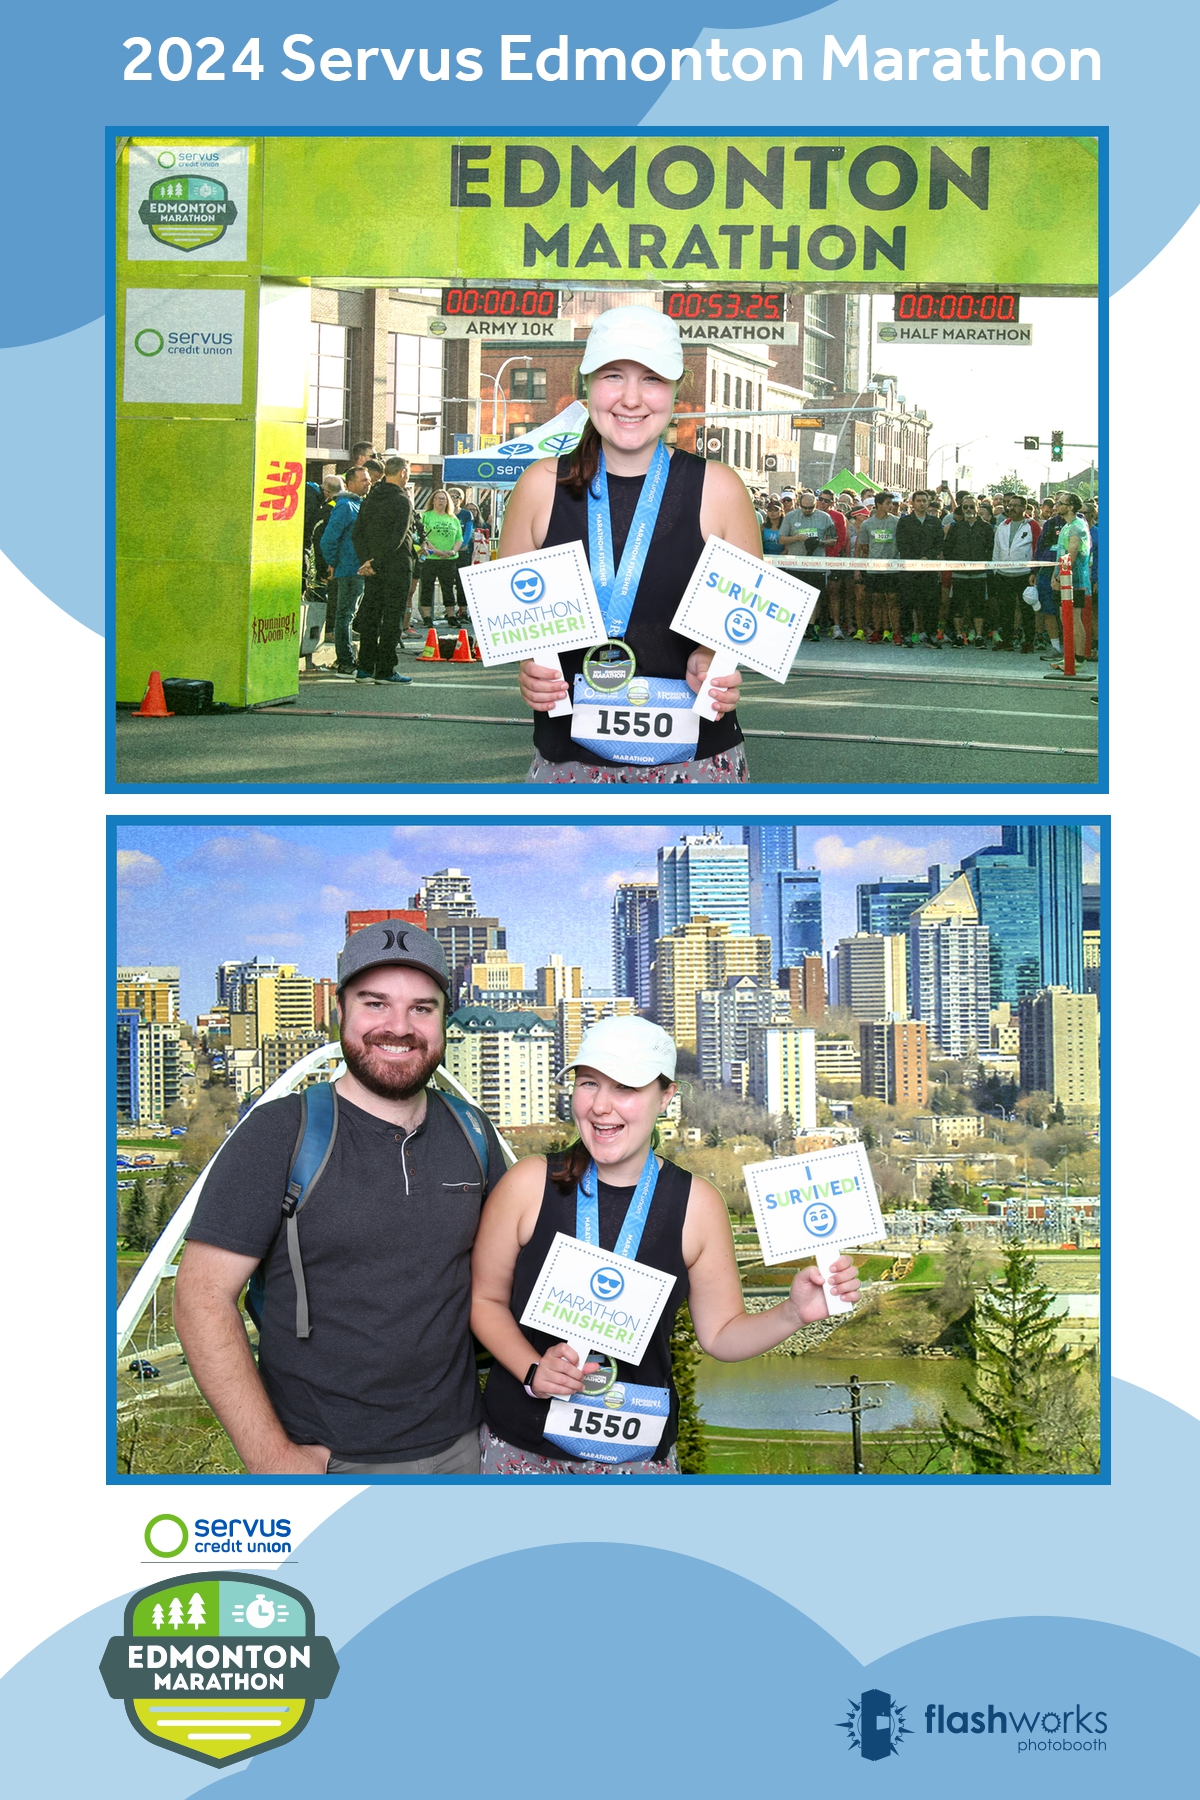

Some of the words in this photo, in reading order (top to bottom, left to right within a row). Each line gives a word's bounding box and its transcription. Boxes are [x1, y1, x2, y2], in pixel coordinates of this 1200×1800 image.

[178, 152, 219, 161] servus
[450, 144, 991, 211] EDMONTON
[149, 203, 227, 213] EDMONTON
[160, 214, 215, 222] MARATHON
[523, 224, 907, 271] MARATHON
[168, 331, 233, 345] servus
[465, 321, 518, 335] ARMY
[521, 322, 554, 336] 10K
[679, 325, 785, 340] MARATHON
[900, 328, 938, 340] HALF
[943, 328, 1031, 341] MARATHON
[168, 345, 200, 355] credit
[202, 345, 233, 355] union
[496, 465, 529, 475] serv
[596, 513, 604, 551] MARATHON
[630, 522, 646, 561] MARATHON
[598, 552, 607, 587] FINISHER
[621, 560, 636, 597] FINISHER
[754, 573, 764, 589] I
[705, 571, 796, 628] SURVIVED!
[487, 598, 582, 632] MARATHON
[491, 614, 586, 647] FINISHER!
[597, 709, 673, 738] 1550
[612, 754, 654, 763] MARATHON
[804, 1165, 813, 1181] I
[765, 1176, 861, 1210] SURVIVED!
[622, 1233, 633, 1257] MARAT
[547, 1286, 641, 1331] MARATHON
[541, 1300, 635, 1345] FINISHER!
[569, 1408, 642, 1440] 1550
[579, 1451, 618, 1462] MARATHON
